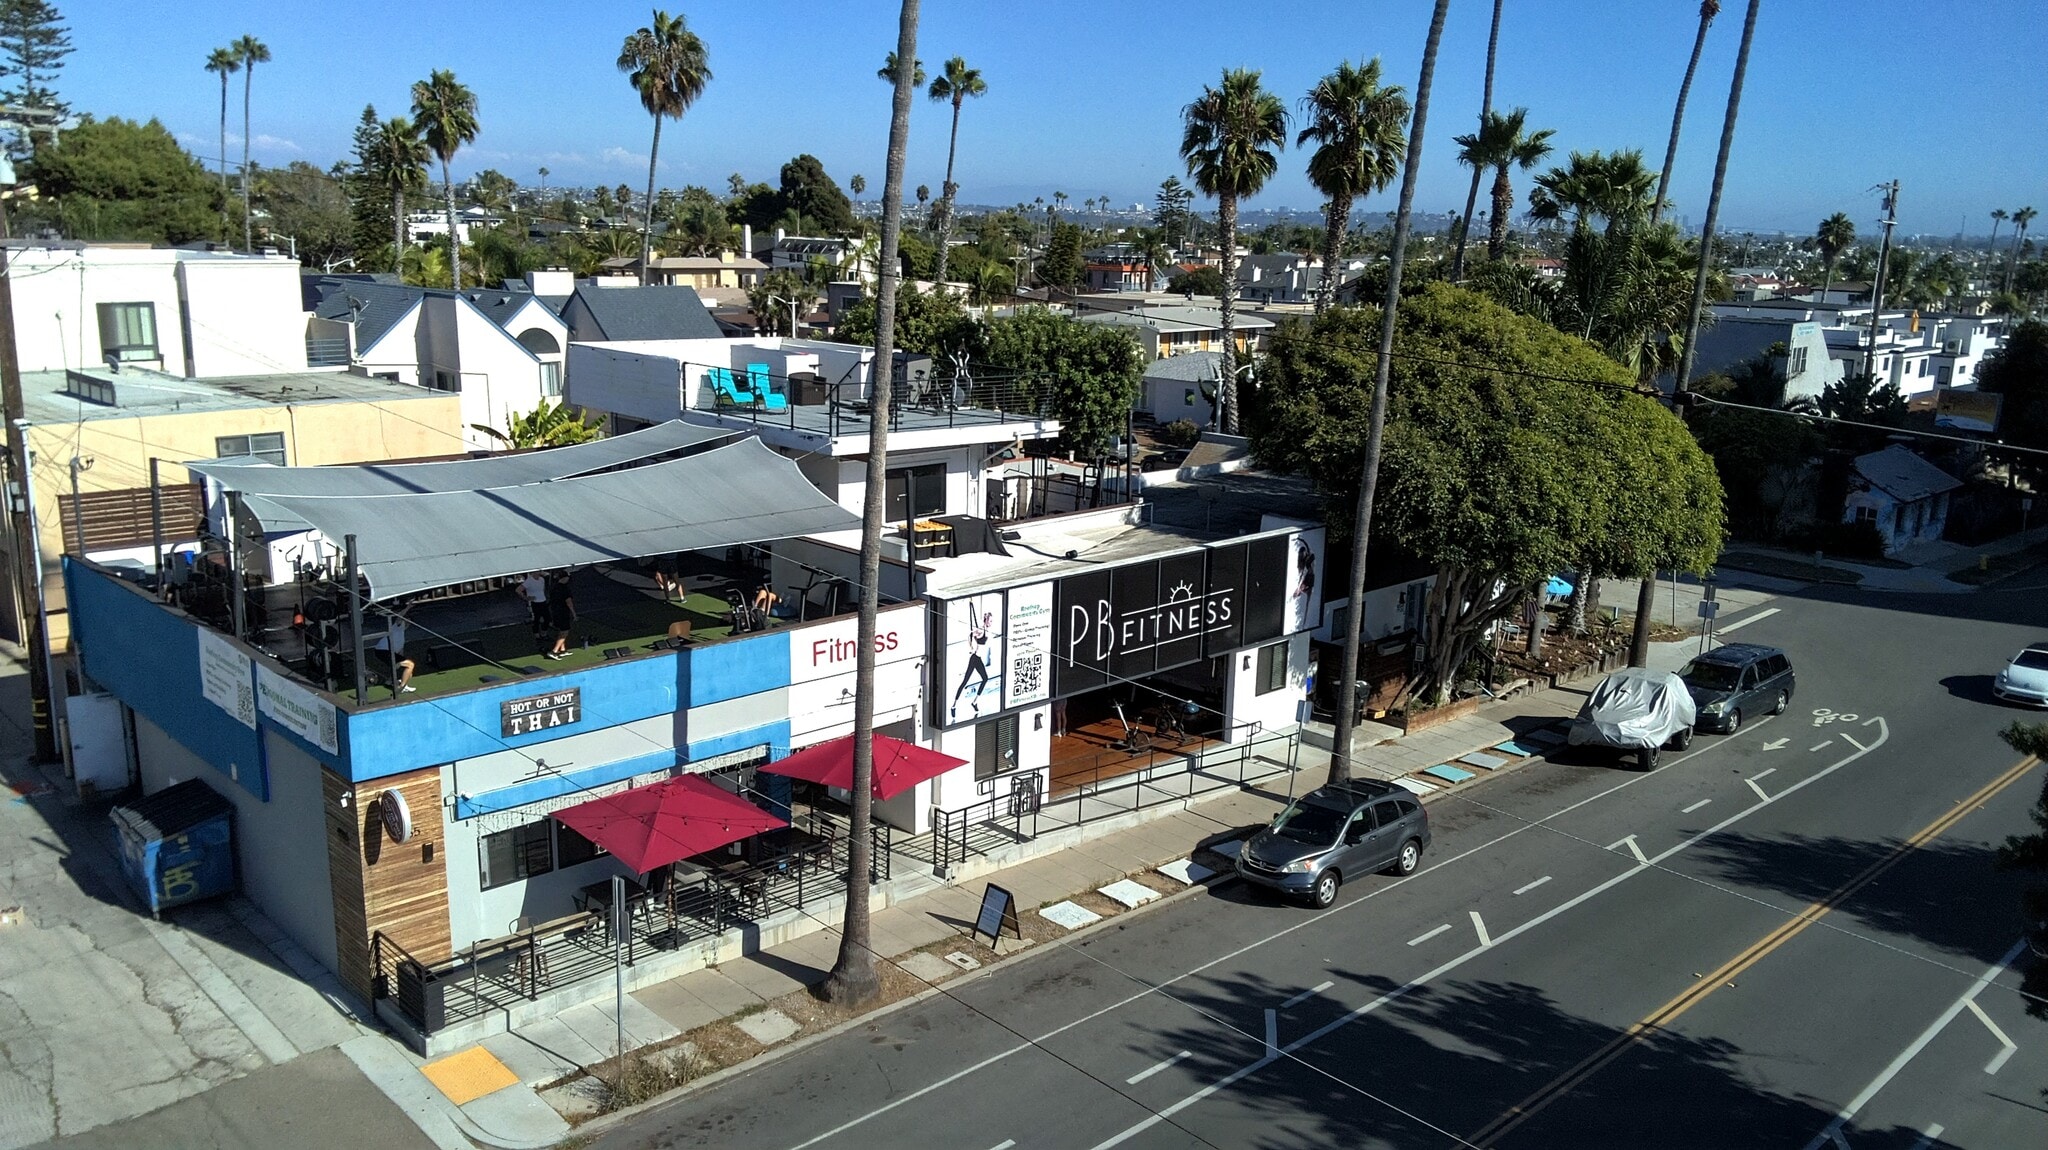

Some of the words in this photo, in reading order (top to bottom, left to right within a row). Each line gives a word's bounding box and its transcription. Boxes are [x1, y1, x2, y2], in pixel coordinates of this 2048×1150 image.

[1070, 599, 1115, 667] PB
[1122, 597, 1231, 646] FITNESS
[812, 631, 899, 667] Fitnss
[510, 701, 532, 715] HOT
[536, 697, 550, 708] OR
[553, 693, 574, 706] NOT
[510, 706, 575, 735] THAI
